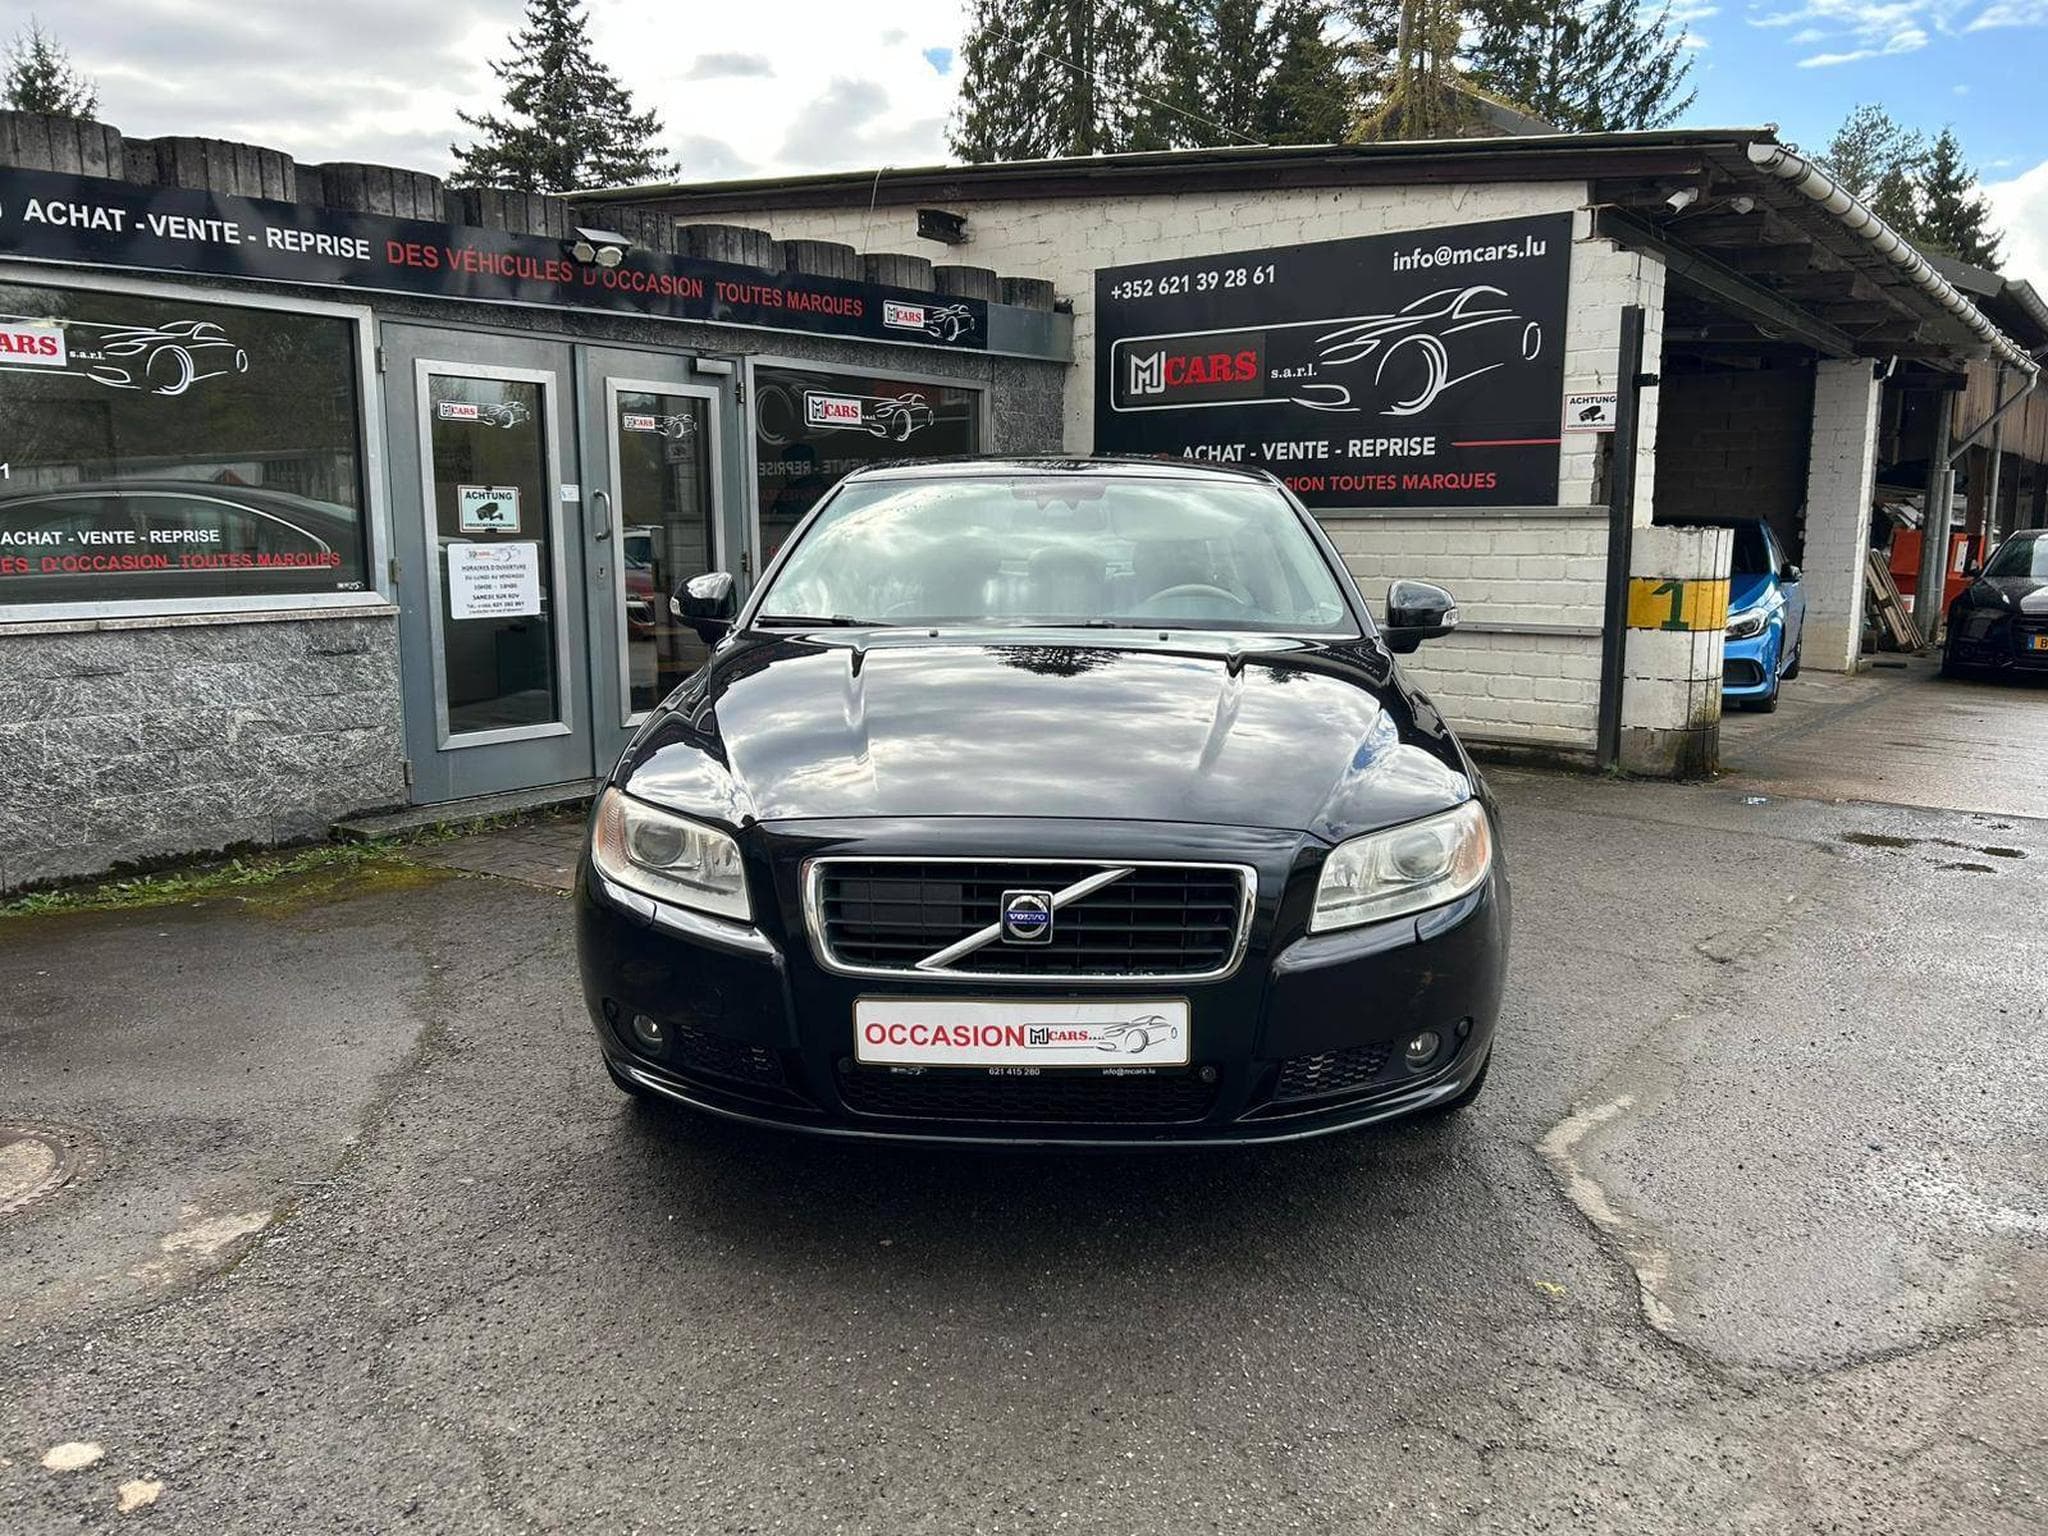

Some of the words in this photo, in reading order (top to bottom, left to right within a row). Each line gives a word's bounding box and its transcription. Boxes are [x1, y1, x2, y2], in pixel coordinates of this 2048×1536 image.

[23, 199, 126, 232] ACHAT
[266, 227, 371, 260] REPRISE
[386, 240, 440, 268] DES
[446, 244, 573, 282] VÉHICULES
[716, 281, 782, 307] TOUTES
[787, 291, 863, 317] MARQUES
[1393, 235, 1547, 272] info@mcars.lu
[1111, 279, 1153, 300] +352
[1158, 275, 1190, 295] 621
[1196, 271, 1219, 291] 39
[1224, 268, 1247, 288] 28
[1253, 264, 1275, 284] 61
[1270, 363, 1317, 379] s.a.r.l.
[1569, 396, 1616, 404] ACHTUNG
[1183, 444, 1246, 462] ACHAT
[1262, 441, 1329, 461] VENTE
[1348, 436, 1436, 458] REPRISE
[1330, 475, 1397, 491] TOUTES
[1402, 472, 1497, 490] MARQUES
[465, 491, 512, 500] ACHTUNG
[1, 531, 63, 545] ACHAT
[78, 531, 136, 544] VENTE
[150, 530, 220, 543] REPRISE
[41, 554, 169, 573] D'OCCASION
[180, 553, 252, 568] TOUTES
[257, 552, 341, 567] MARQUES
[1652, 581, 1689, 631] 1
[1009, 913, 1046, 921] VOLVO
[865, 1023, 1025, 1047] OCCASION
